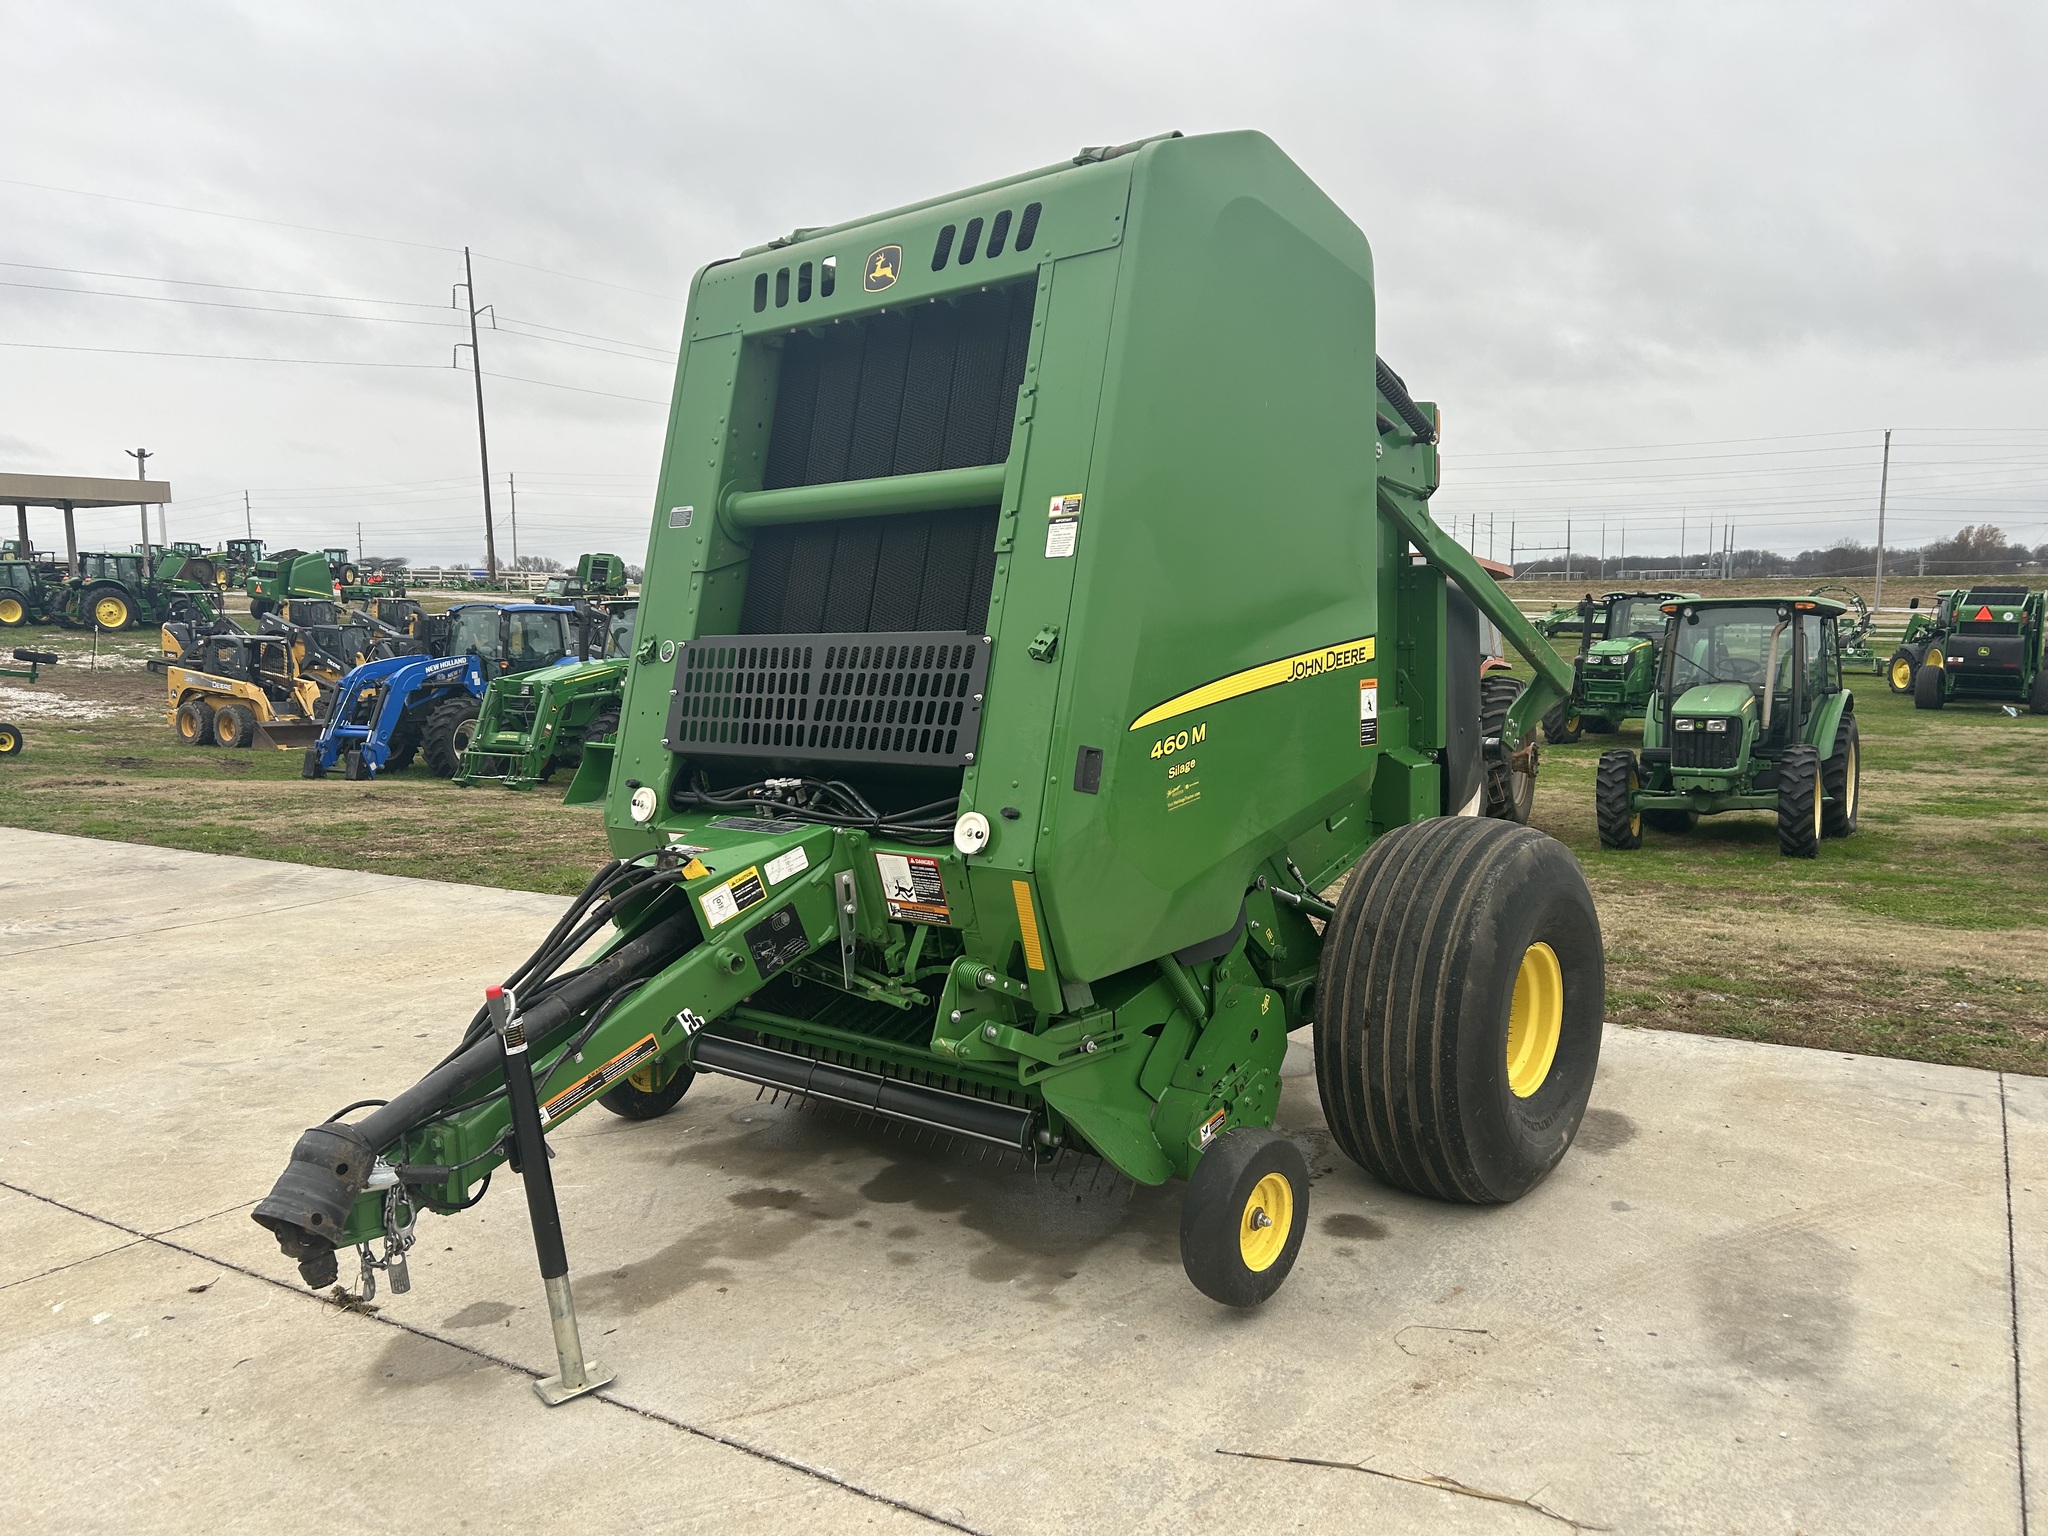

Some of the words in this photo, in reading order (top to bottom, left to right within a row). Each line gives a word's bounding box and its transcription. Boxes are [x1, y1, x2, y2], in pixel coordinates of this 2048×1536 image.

[425, 664, 440, 673] NEW
[440, 657, 467, 668] HOLLAND
[1288, 655, 1324, 682] JOHN
[1326, 646, 1367, 672] DEERE
[211, 681, 232, 690] DEERE
[1150, 729, 1189, 760] 460
[1191, 722, 1207, 744] M
[1168, 758, 1196, 780] Silage
[914, 858, 935, 866] DANGER
[735, 871, 754, 884] CAUTION
